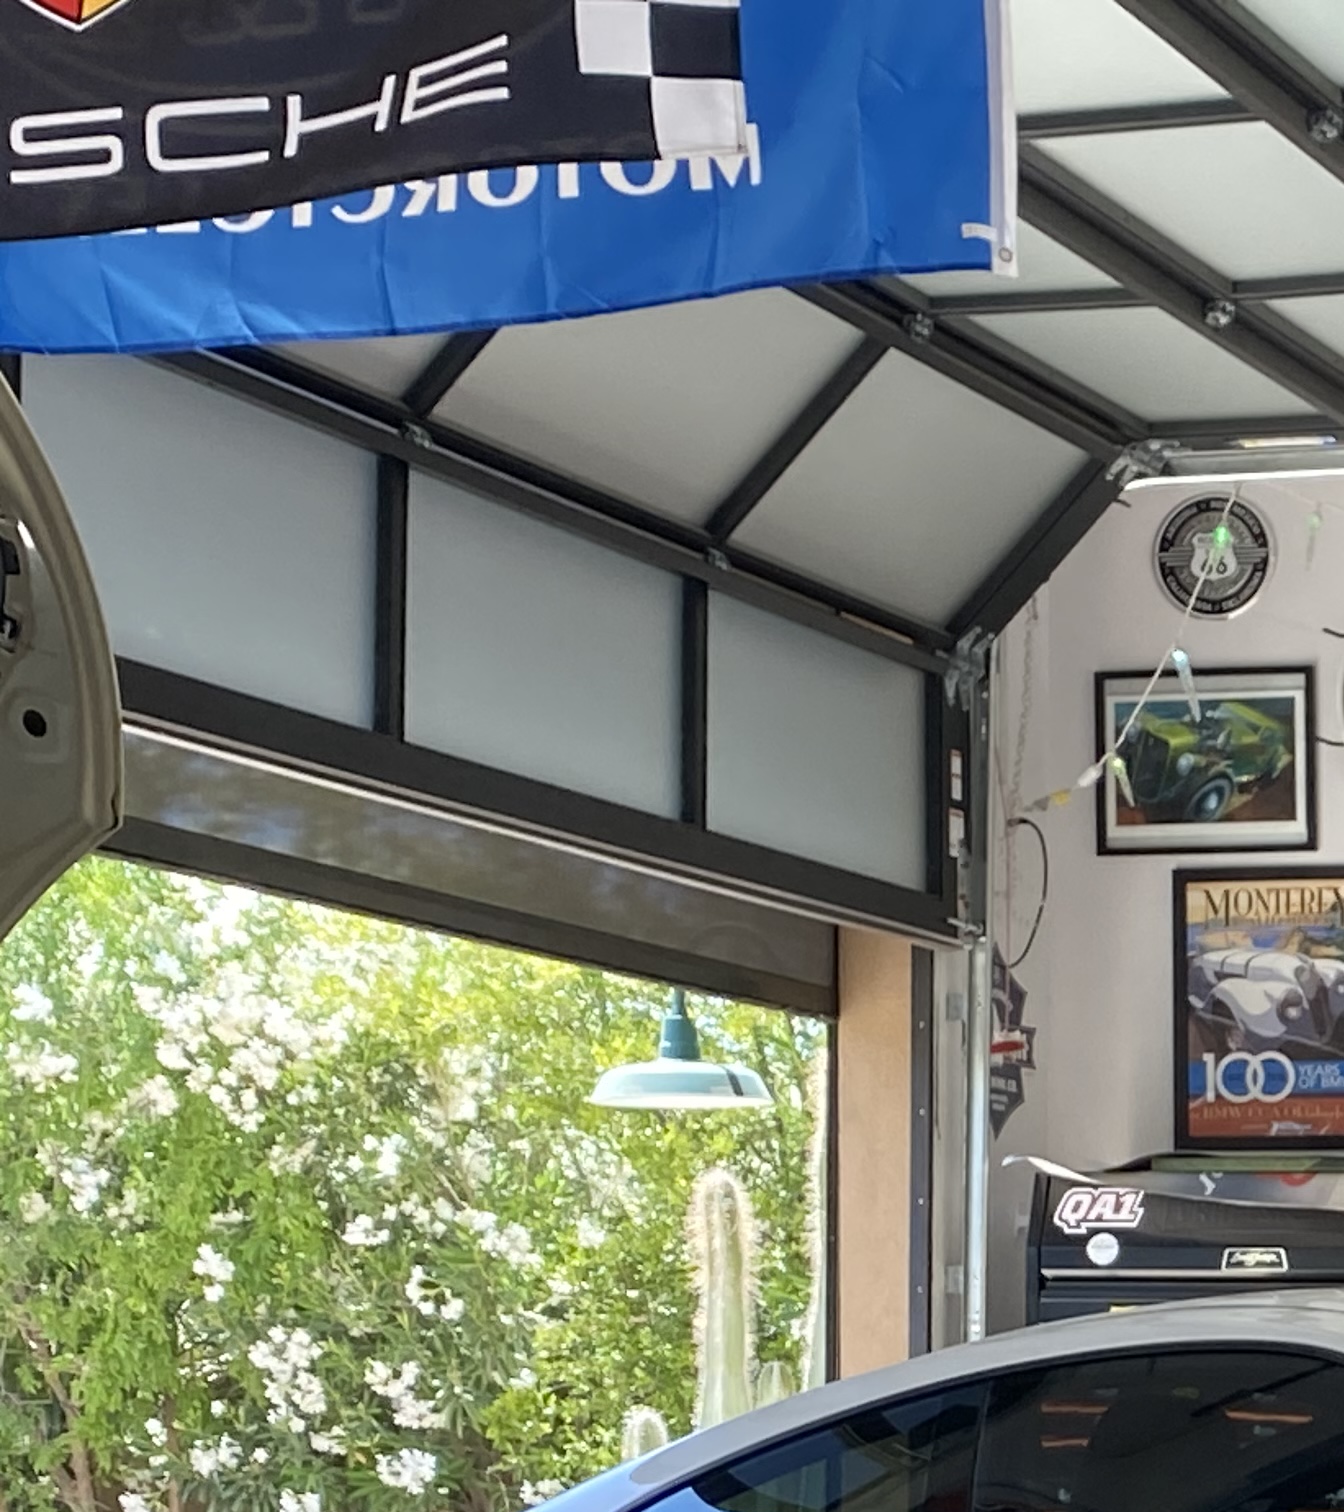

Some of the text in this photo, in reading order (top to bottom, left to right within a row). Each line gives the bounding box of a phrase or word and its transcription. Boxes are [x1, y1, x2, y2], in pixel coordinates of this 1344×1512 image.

[1203, 1050, 1297, 1104] 100
[1299, 1064, 1341, 1076] YEARS
[1299, 1075, 1317, 1089] OF
[1060, 1193, 1138, 1226] QA1
